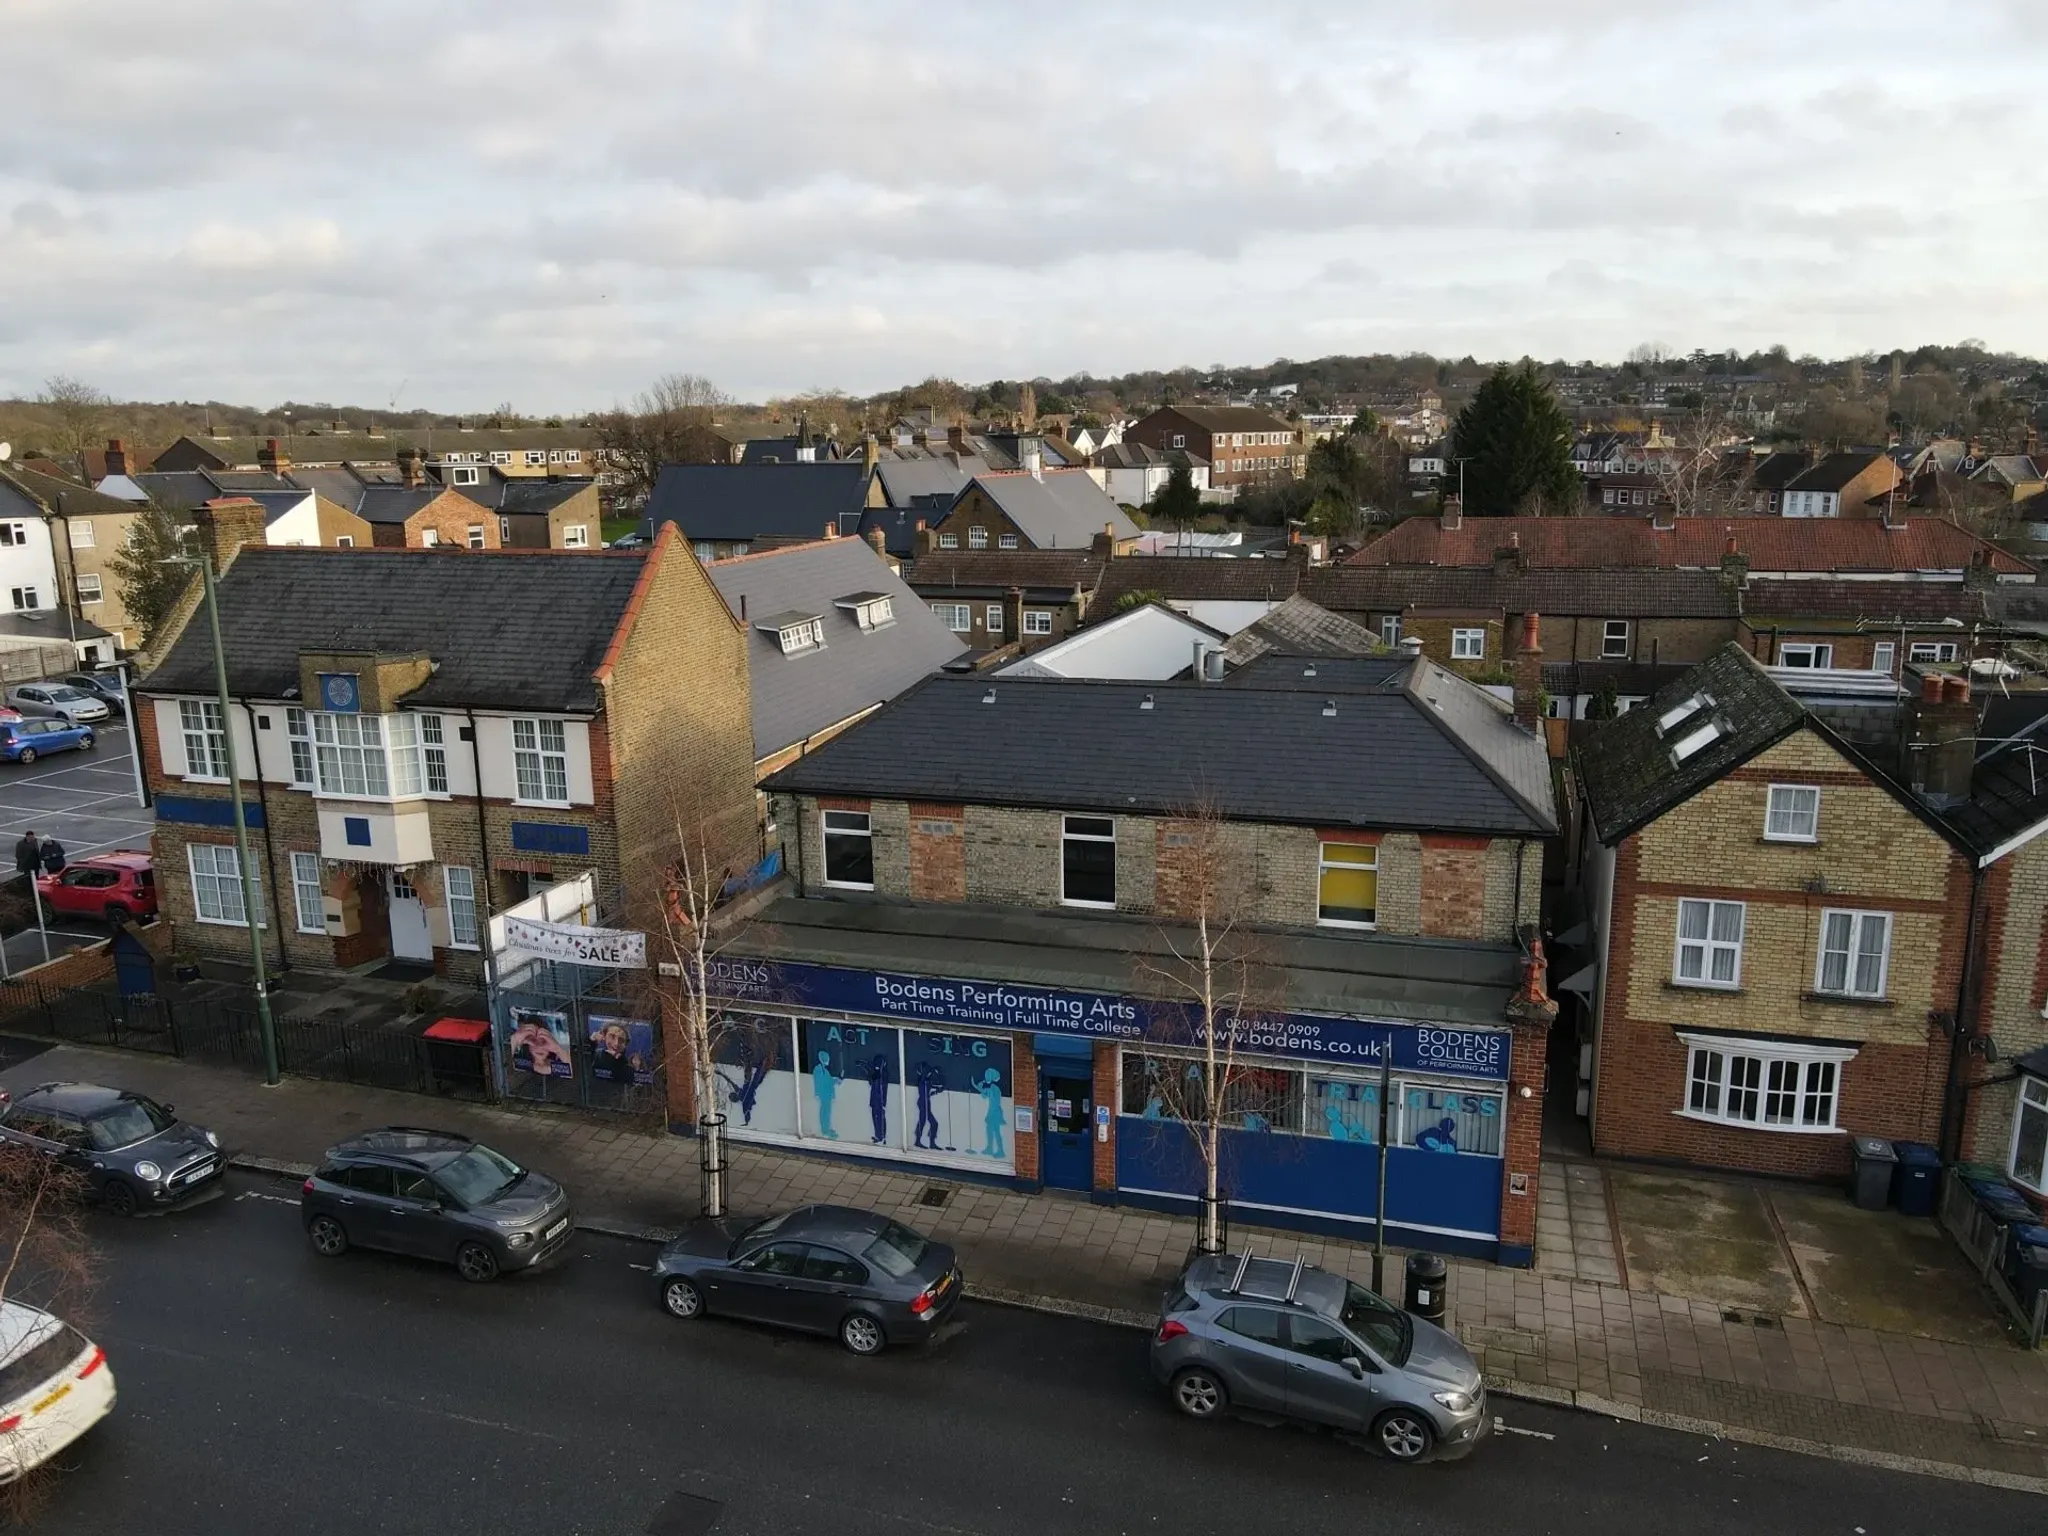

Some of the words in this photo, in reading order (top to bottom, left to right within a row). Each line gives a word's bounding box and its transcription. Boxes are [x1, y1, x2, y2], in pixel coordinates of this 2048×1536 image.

[579, 945, 621, 963] SALE
[874, 976, 956, 1002] Bodens
[961, 985, 1084, 1019] Performing
[1089, 999, 1136, 1020] Arts
[881, 997, 908, 1012] Part
[909, 1000, 945, 1015] Time
[949, 1004, 1004, 1024] Training
[1015, 1011, 1041, 1026] Full
[1042, 1014, 1080, 1029] Time
[1083, 1018, 1142, 1036] College
[1253, 1019, 1284, 1034] 8447
[1287, 1023, 1321, 1037] 0909
[1195, 1027, 1382, 1057] www.bodens.co.uk
[1418, 1028, 1500, 1051] BODENS
[1417, 1043, 1500, 1065] COLLEGE
[1429, 1061, 1479, 1072] PERFORMING
[1479, 1066, 1499, 1075] ARTS
[1408, 1089, 1499, 1117] CLASS
